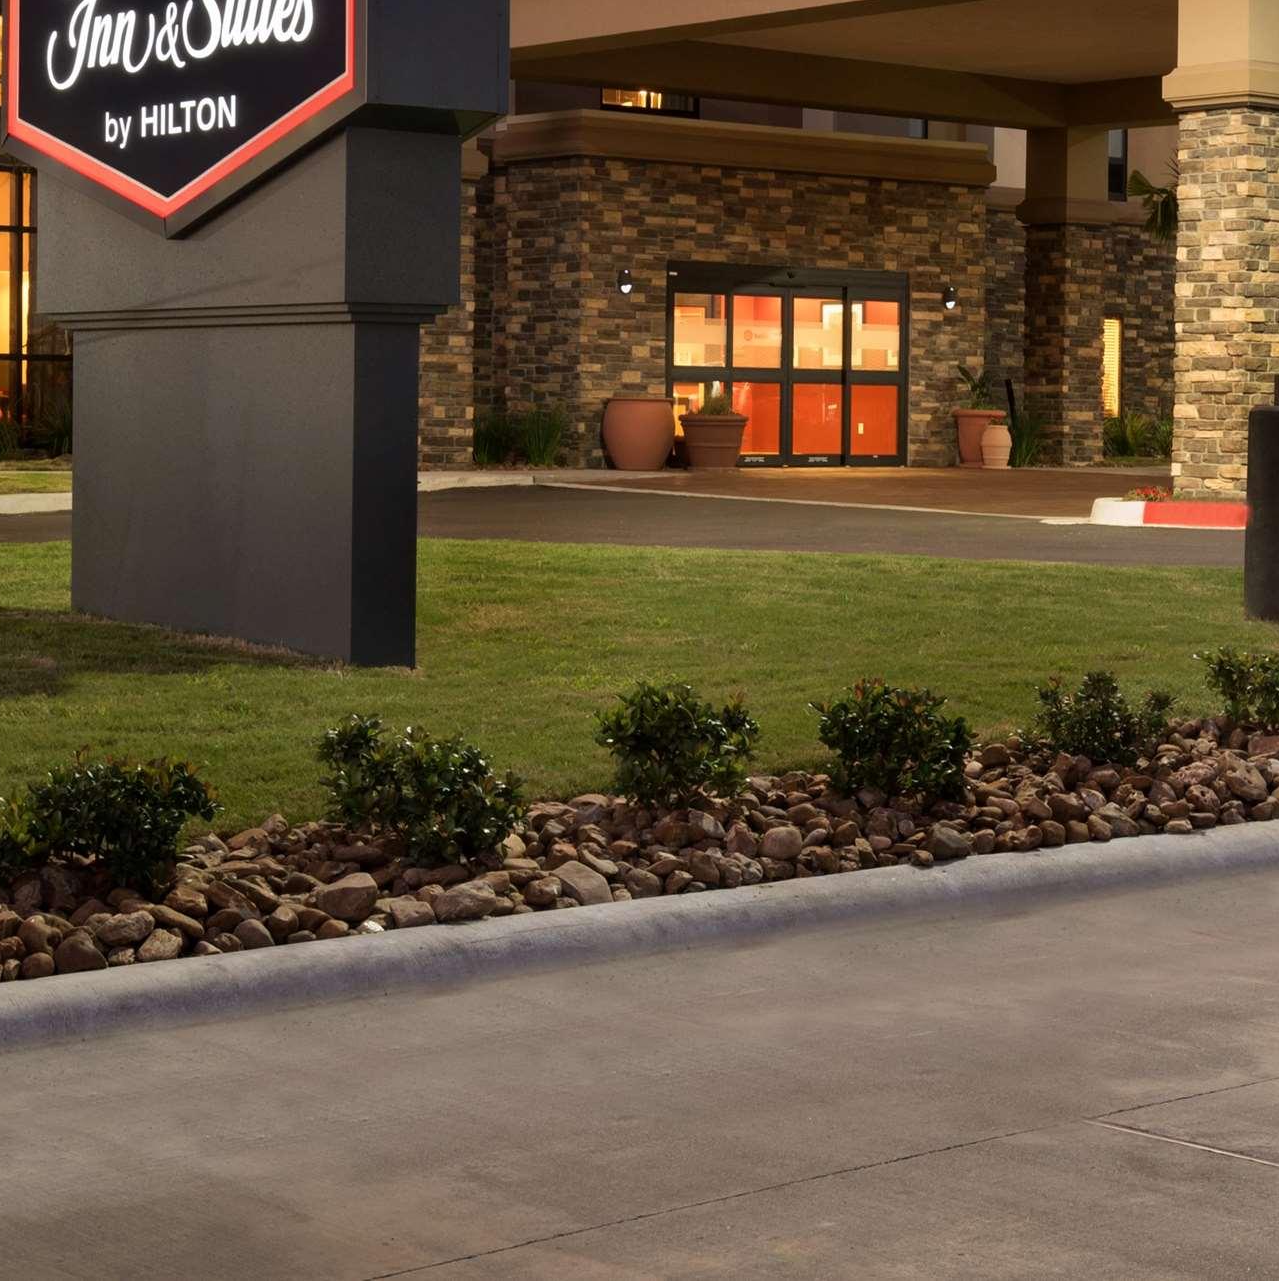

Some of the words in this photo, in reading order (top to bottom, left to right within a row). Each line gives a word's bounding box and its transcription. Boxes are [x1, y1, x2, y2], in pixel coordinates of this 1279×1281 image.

[154, 2, 185, 68] &
[104, 111, 132, 149] by
[140, 95, 237, 139] HILTON
